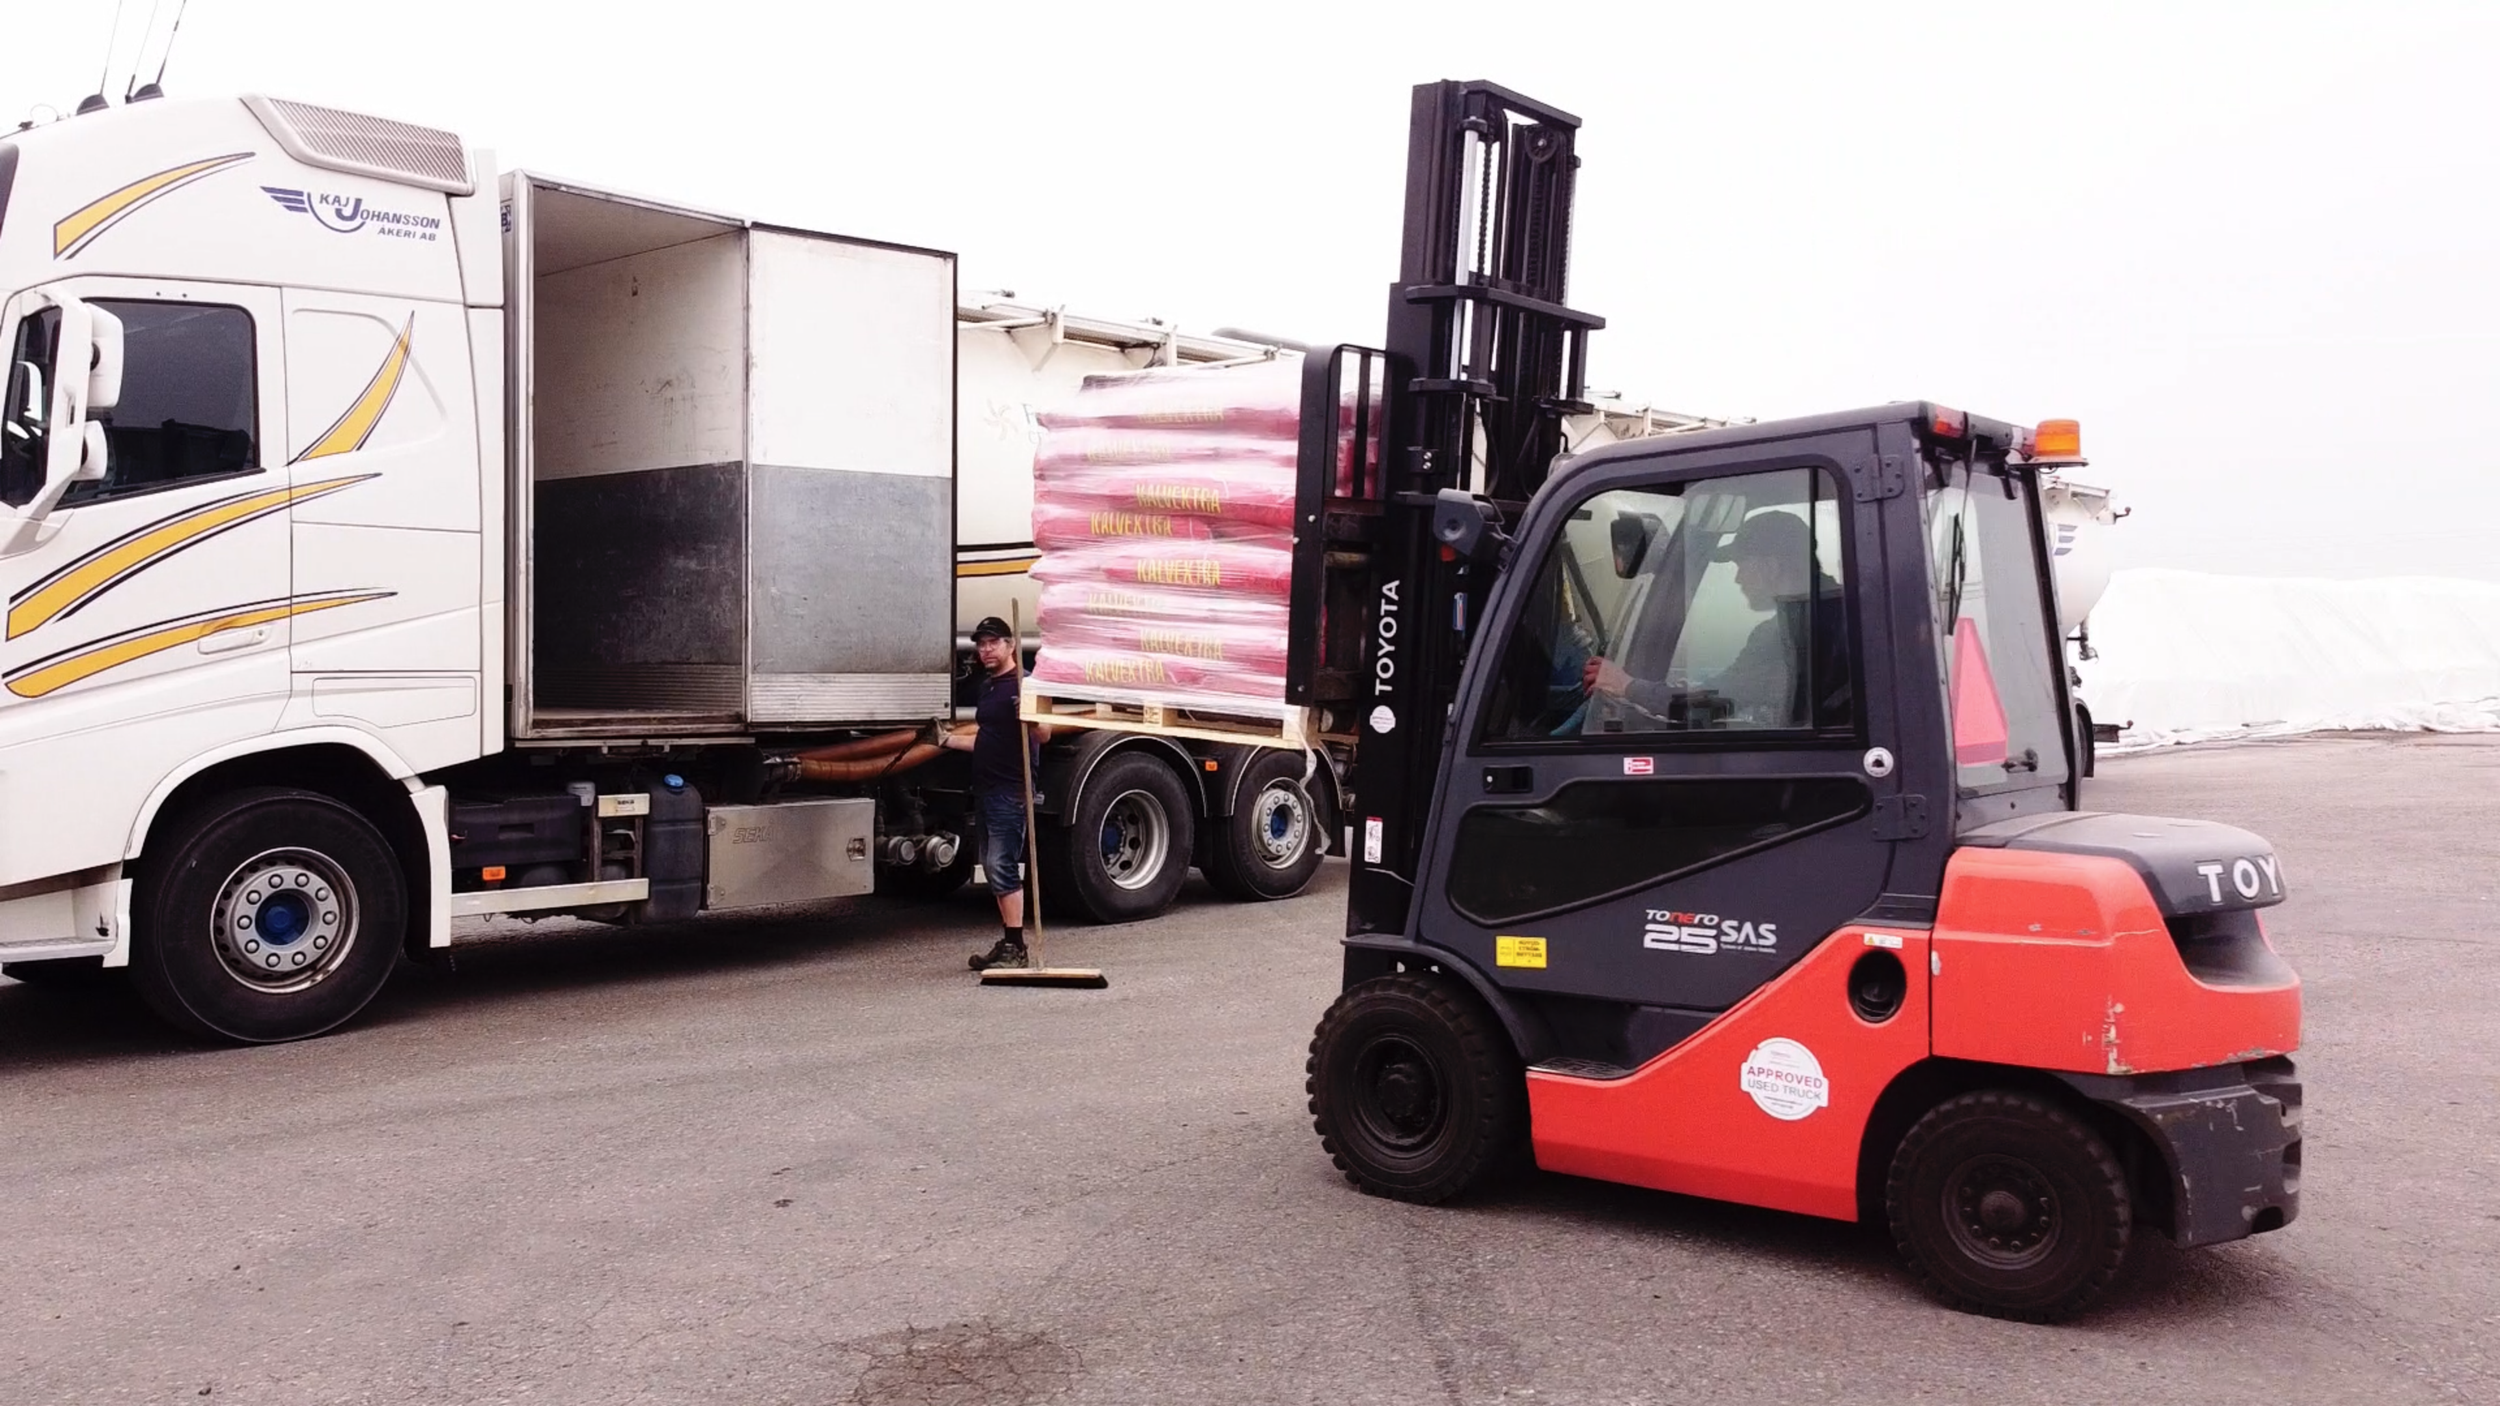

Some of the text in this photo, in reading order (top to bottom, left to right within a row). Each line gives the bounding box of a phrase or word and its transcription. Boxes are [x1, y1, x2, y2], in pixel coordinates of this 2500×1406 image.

[319, 193, 351, 208] KAJ
[335, 198, 441, 230] JOHANSSON
[419, 232, 437, 242] AB
[1136, 484, 1222, 514] KALVEXTRA
[1090, 512, 1173, 536] KALVEXTRA
[1137, 559, 1221, 587] KALVEXTRA
[1375, 580, 1401, 695] TOYOTA
[1085, 659, 1167, 684] KALVEXTRA
[2197, 856, 2279, 903] TOY
[1643, 920, 1777, 954] 25 SAS
[1747, 1066, 1823, 1089] APPROVED
[1748, 1078, 1822, 1101] USED TRUCK
